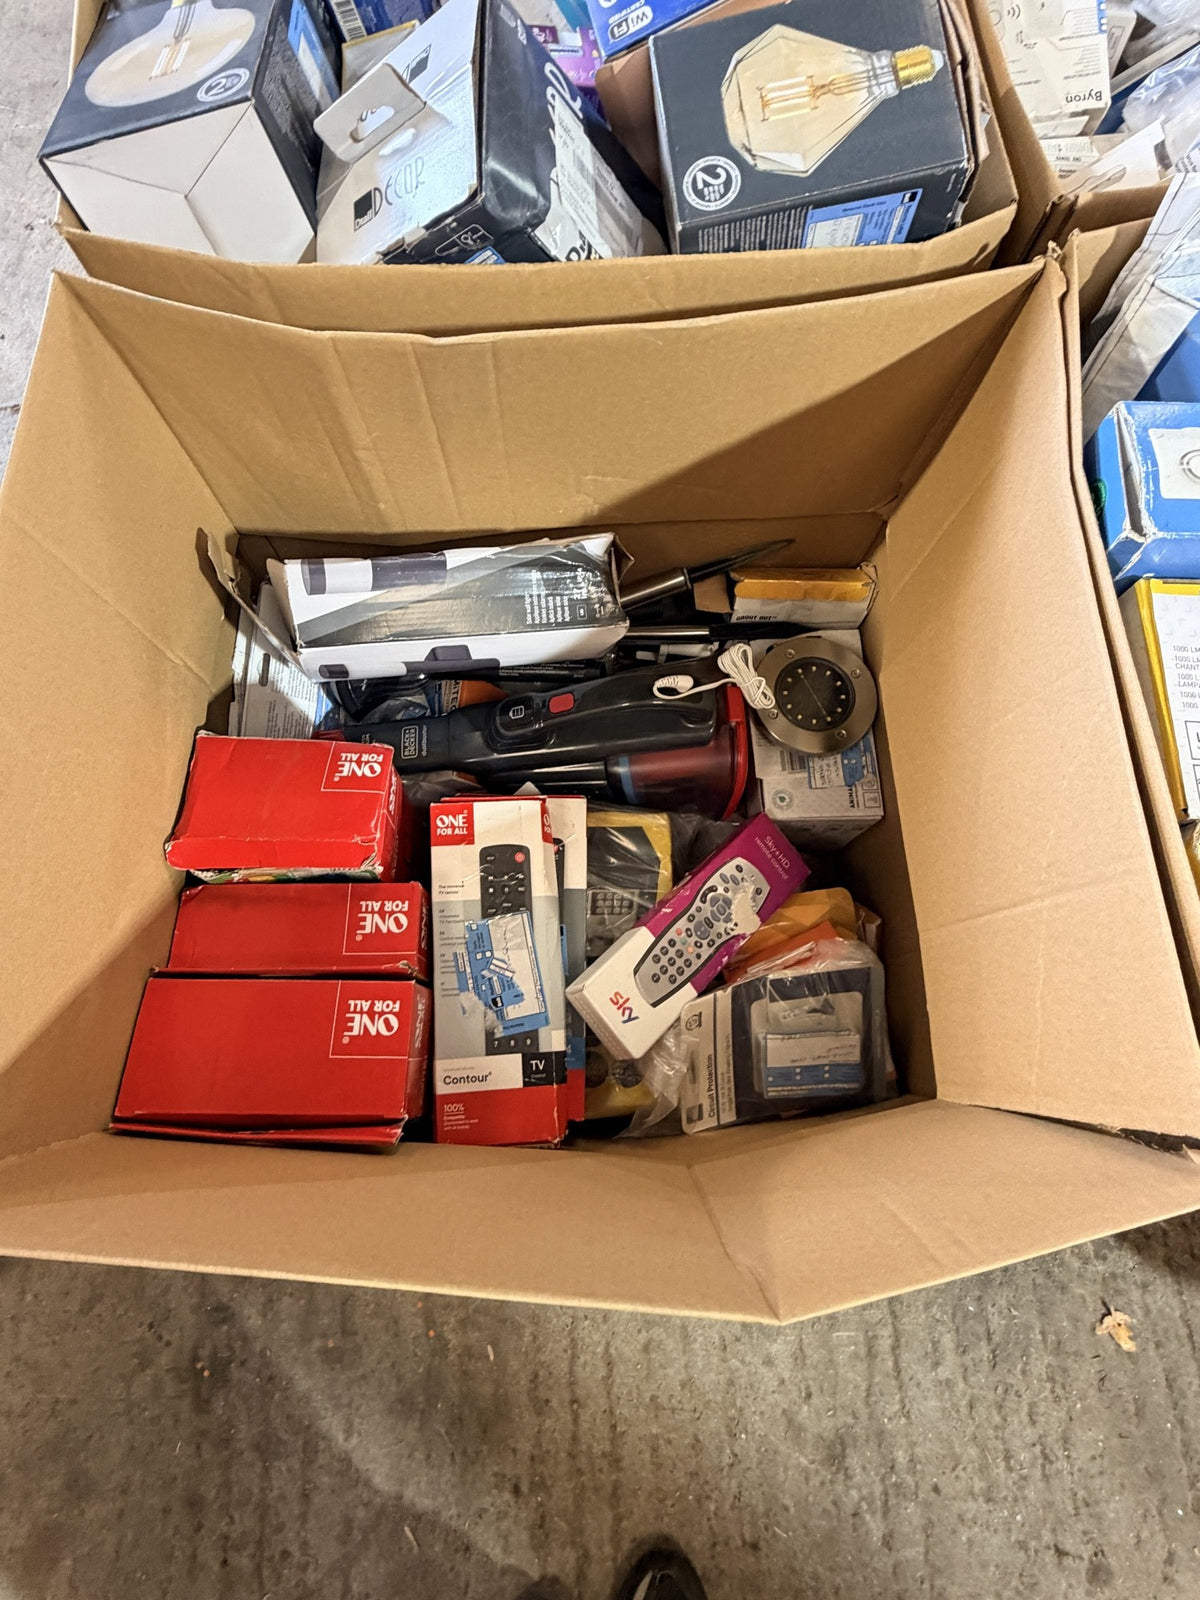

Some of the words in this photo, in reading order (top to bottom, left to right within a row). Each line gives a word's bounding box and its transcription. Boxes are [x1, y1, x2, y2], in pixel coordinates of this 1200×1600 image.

[207, 79, 227, 96] 2
[1065, 90, 1103, 104] Byron
[1173, 645, 1189, 653] 1000
[340, 752, 358, 761] ALL
[362, 752, 384, 762] FOR
[436, 828, 452, 836] FOR
[453, 827, 468, 835] ALL
[754, 837, 773, 859] remote
[770, 857, 790, 881] control
[360, 900, 381, 912] ALL
[384, 900, 409, 912] FOR
[348, 999, 371, 1012] ALL
[374, 1000, 400, 1012] FOR
[609, 991, 640, 1024] sky
[529, 1059, 546, 1071] TV
[706, 1054, 714, 1091] Protection
[443, 1073, 490, 1085] Contour
[443, 1103, 465, 1112] 100%
[707, 1092, 715, 1118] Circuit
